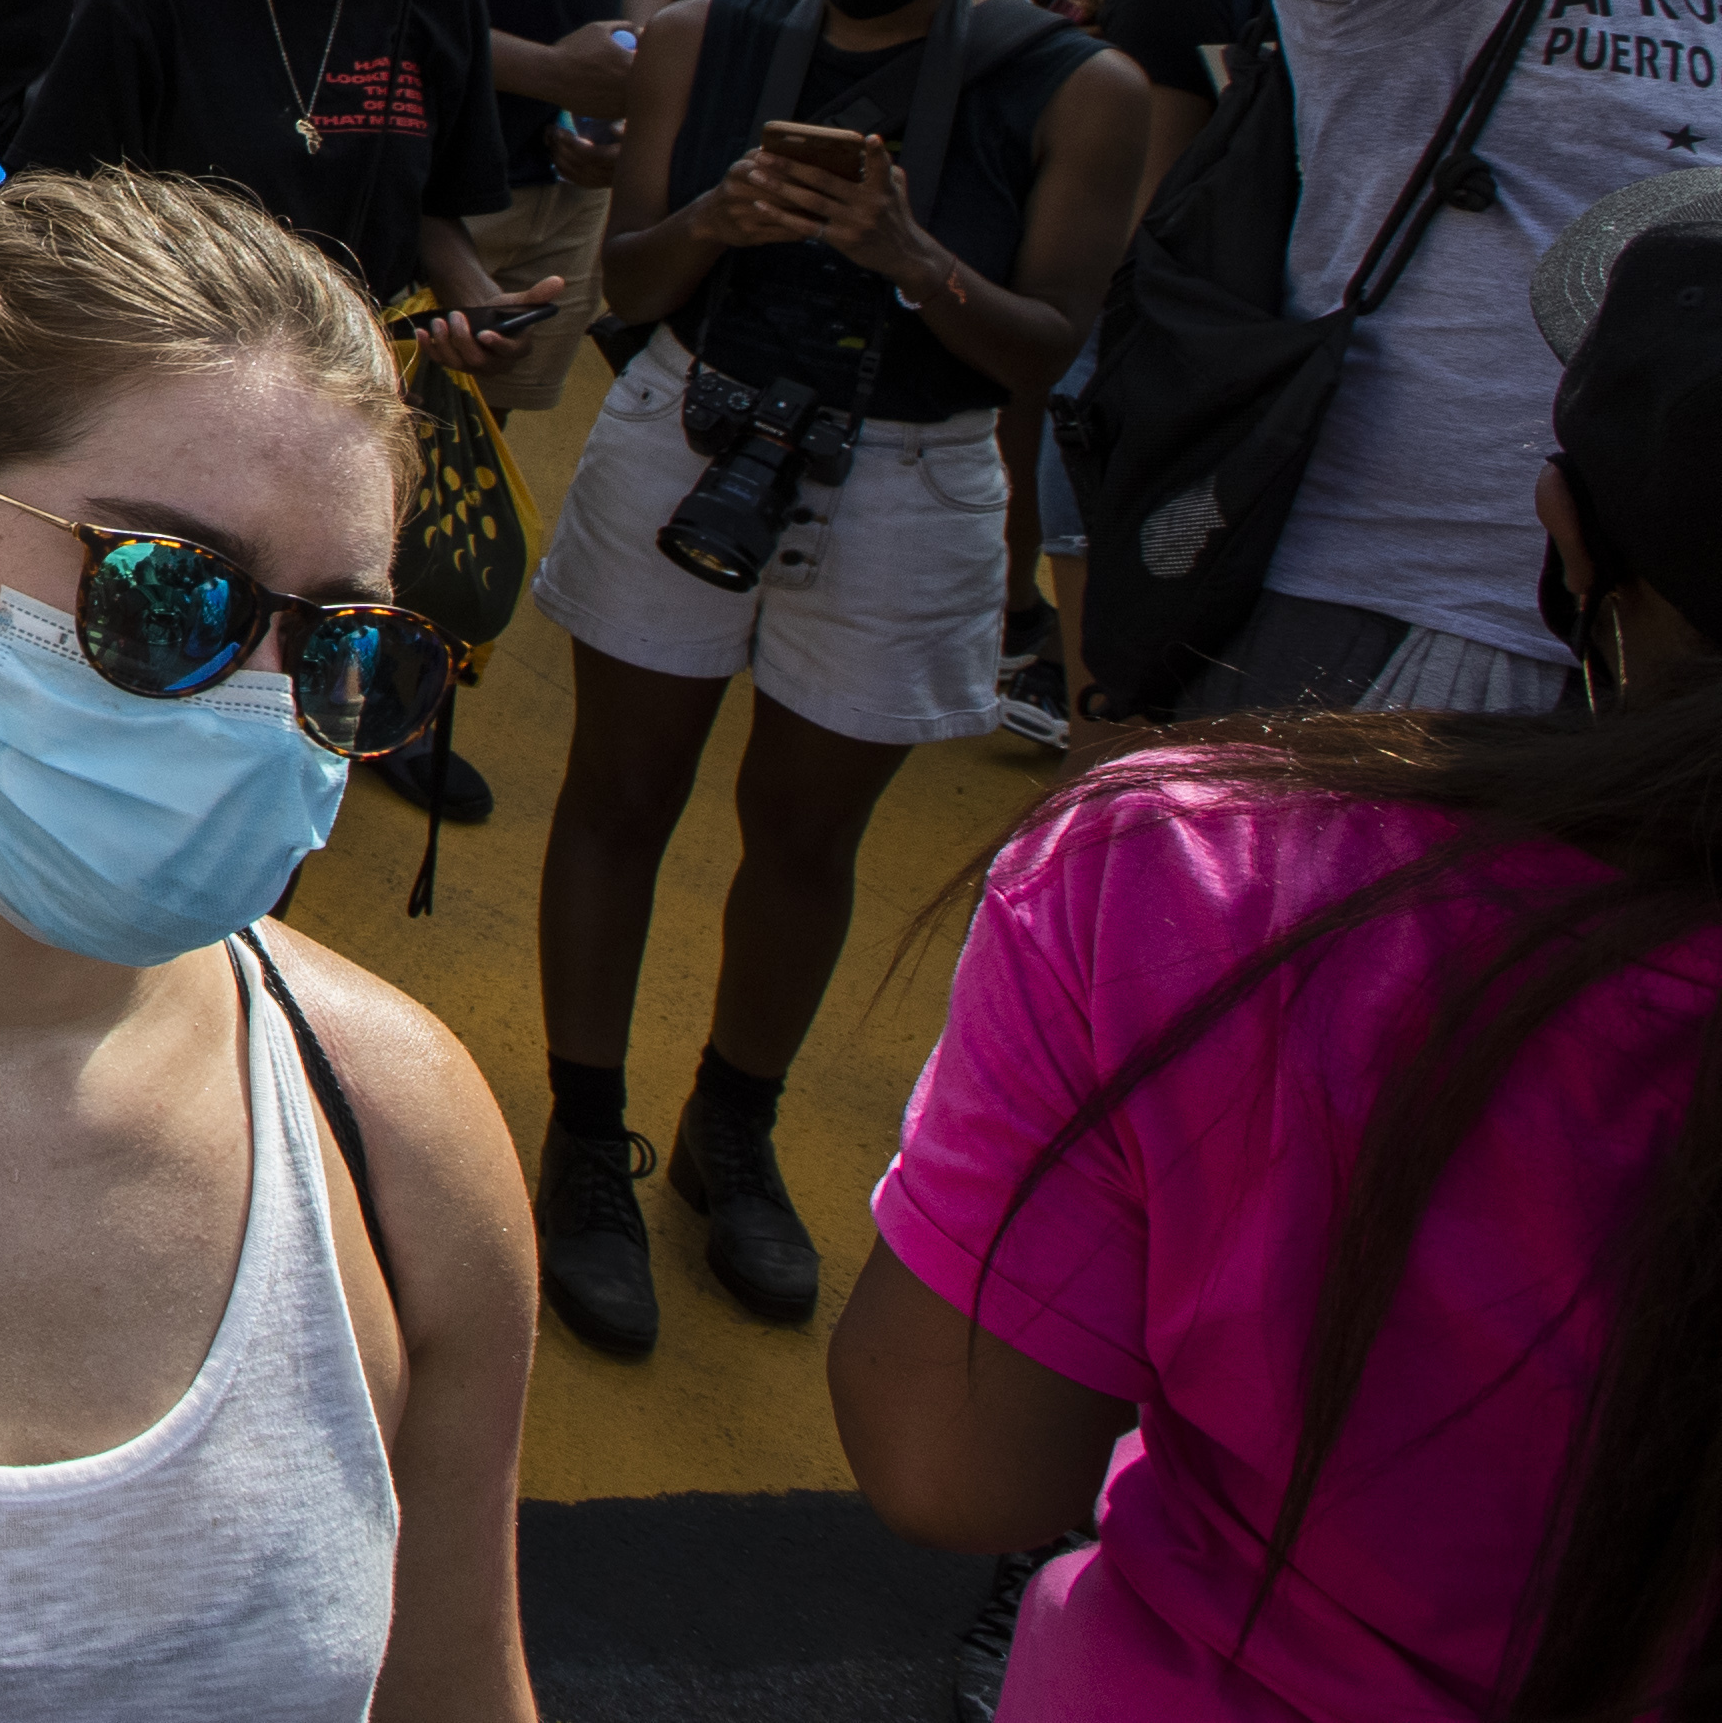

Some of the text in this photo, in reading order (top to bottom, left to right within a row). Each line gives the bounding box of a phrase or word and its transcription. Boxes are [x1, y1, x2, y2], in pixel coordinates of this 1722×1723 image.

[1541, 25, 1716, 88] PUERTO
[354, 57, 391, 71] HAV
[325, 71, 390, 84] LOOKE
[362, 85, 389, 96] TH
